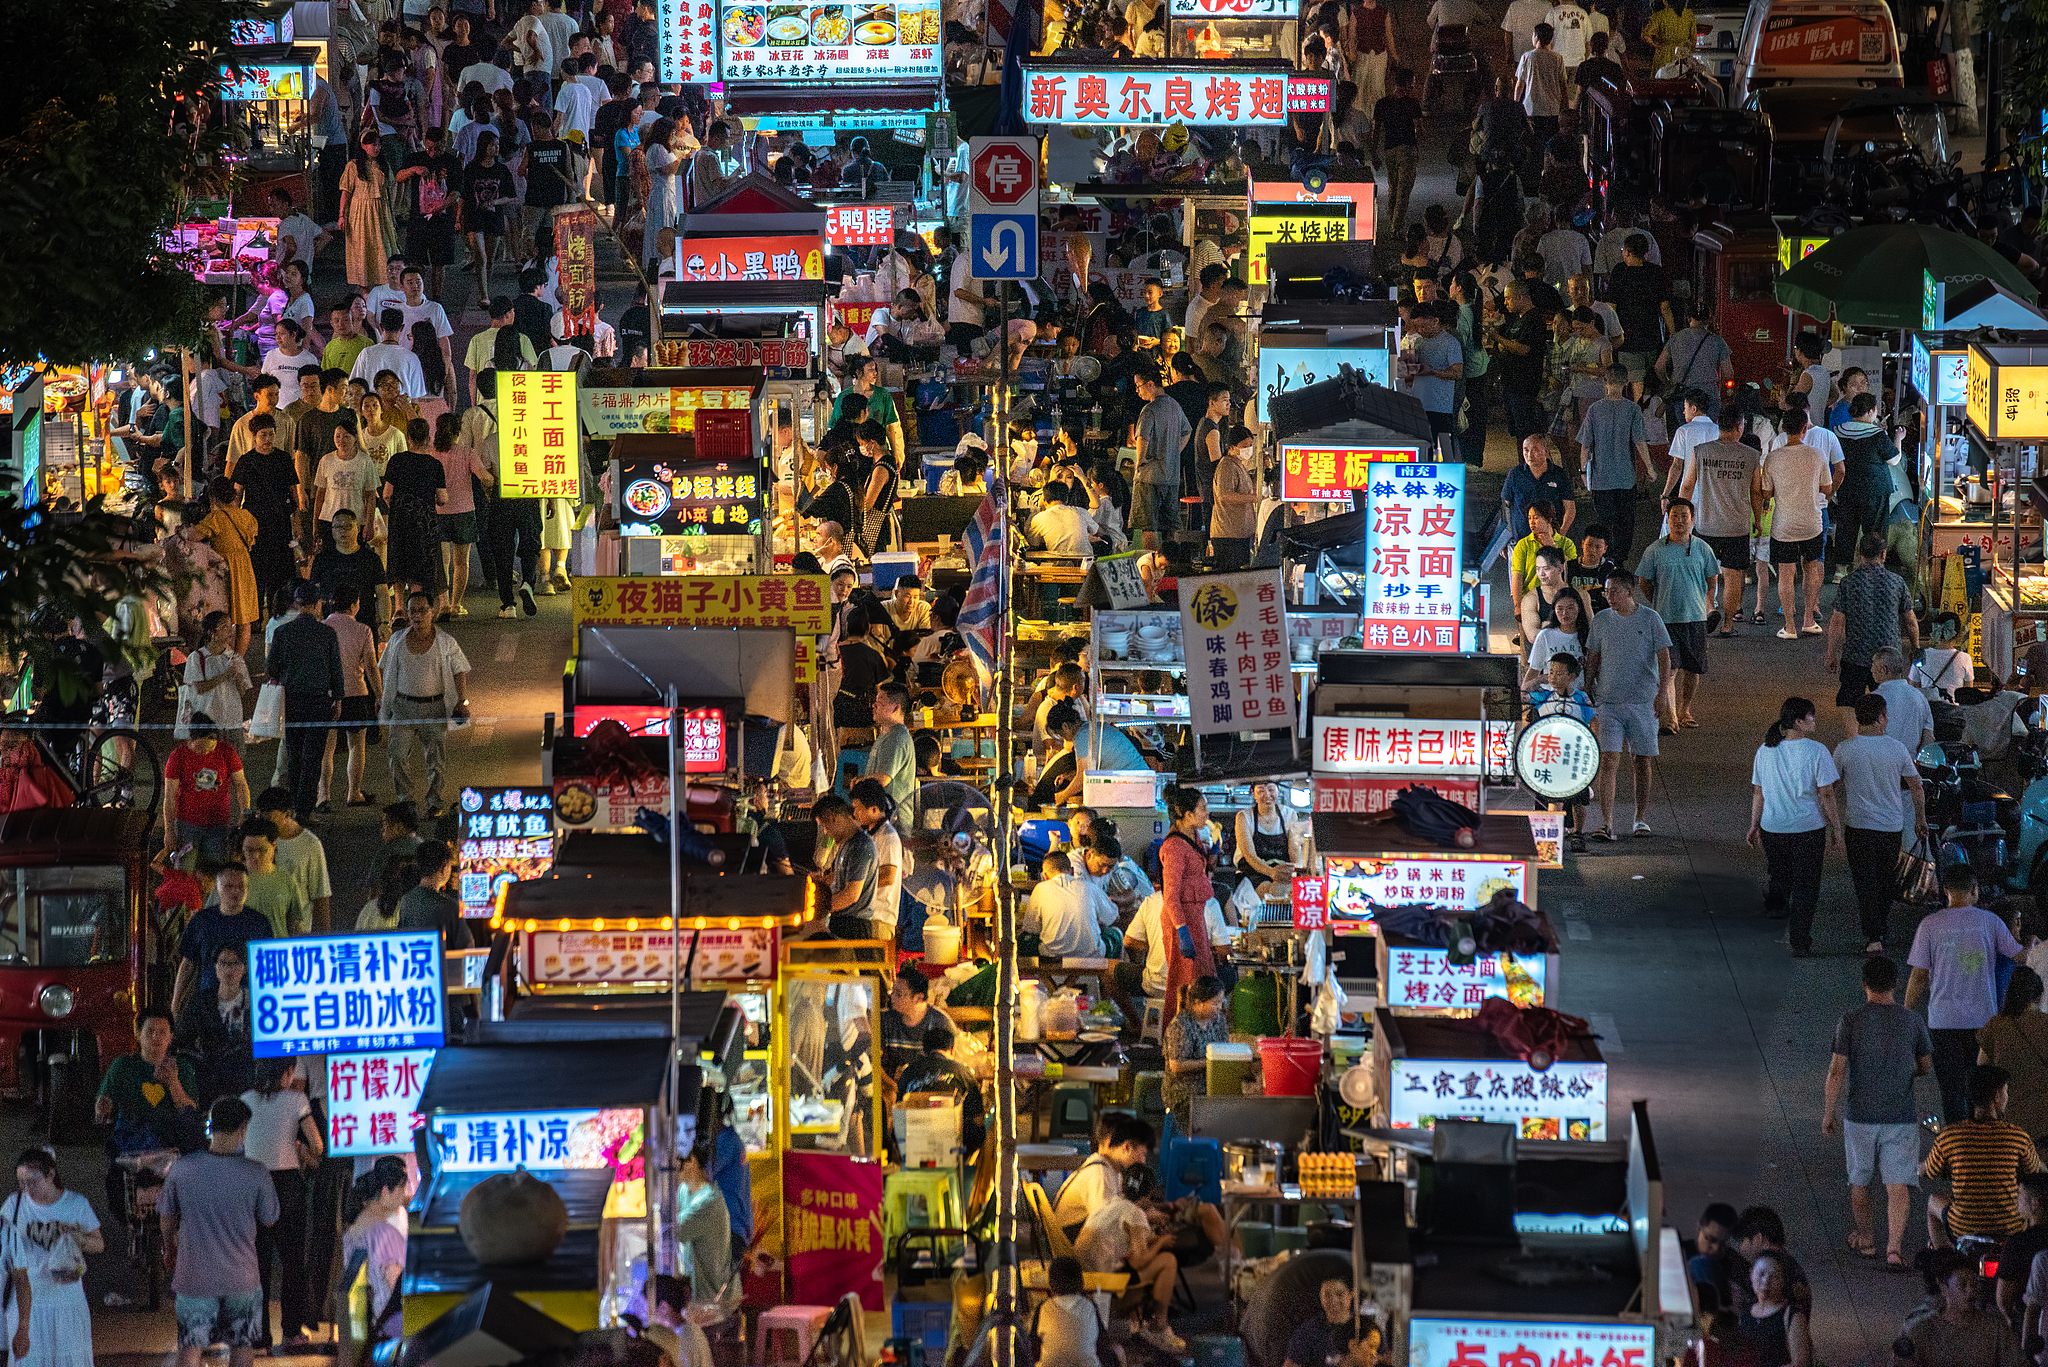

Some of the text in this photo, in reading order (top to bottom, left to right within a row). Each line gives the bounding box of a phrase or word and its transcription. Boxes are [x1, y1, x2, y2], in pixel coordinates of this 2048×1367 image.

[910, 48, 933, 59] 凉虾
[1770, 32, 1800, 52] 拉货
[1809, 40, 1855, 61] 运大件
[732, 50, 755, 61] 冰粉
[769, 50, 804, 61] 冰豆花
[814, 49, 848, 60] 冰汤圆
[866, 49, 889, 59] 凉糕
[1934, 66, 1946, 77] DU
[1029, 75, 1285, 121] 新奥尔良烤翅
[1310, 99, 1325, 109] 米饭
[985, 154, 1022, 194] 停
[1253, 221, 1346, 243] 一米烧烤
[709, 249, 802, 281] 小黑鸭
[1813, 261, 1843, 278] oppo
[1944, 273, 1985, 285] oppo
[688, 340, 808, 367] 孜然小面筋
[601, 392, 669, 409] 福鼎肉片
[675, 390, 750, 410] 土豆泥
[511, 373, 528, 475] 夜猫子小黄鱼
[542, 374, 565, 475] 手工面筋
[1307, 452, 1409, 488] 犟板
[1401, 466, 1430, 477] 南充
[503, 479, 577, 495] 一元烧烤
[672, 475, 757, 499] 砂锅米线
[1371, 480, 1461, 499] 钵钵粉
[677, 504, 749, 525] 小菜自选
[1373, 504, 1456, 537] 凉皮
[1372, 545, 1456, 578] 凉面
[616, 579, 824, 614] 夜猫子小黄鱼
[1383, 583, 1443, 598] 抄手
[1190, 585, 1238, 628] 傣
[1372, 602, 1452, 616] 酸辣粉 土豆粉
[1369, 624, 1455, 647] 特色小面
[1973, 628, 1982, 664] 禁止停车
[1256, 582, 1288, 717] 香毛草罗非鱼
[1206, 635, 1233, 724] 味春鸡脚
[1235, 631, 1262, 719] 牛肉干巴
[1530, 732, 1561, 765] 傣
[1534, 768, 1553, 784] 味
[468, 813, 549, 838] 烤鱿鱼
[461, 839, 553, 859] 免费送土豆
[1385, 868, 1466, 882] 砂锅米线
[1298, 879, 1323, 902] 凉
[1384, 886, 1465, 900] 炒饭 炒河粉
[1299, 905, 1325, 928] 凉
[255, 940, 434, 989] 椰奶清补凉
[1404, 981, 1488, 1004] 烤冷面
[257, 986, 437, 1034] 8元自助冰粉
[330, 1057, 421, 1102] 柠檬水
[1404, 1070, 1594, 1100] 正宗重庆酸辣粉
[468, 1118, 569, 1163] 清补凉
[801, 1188, 858, 1210] 多种口味
